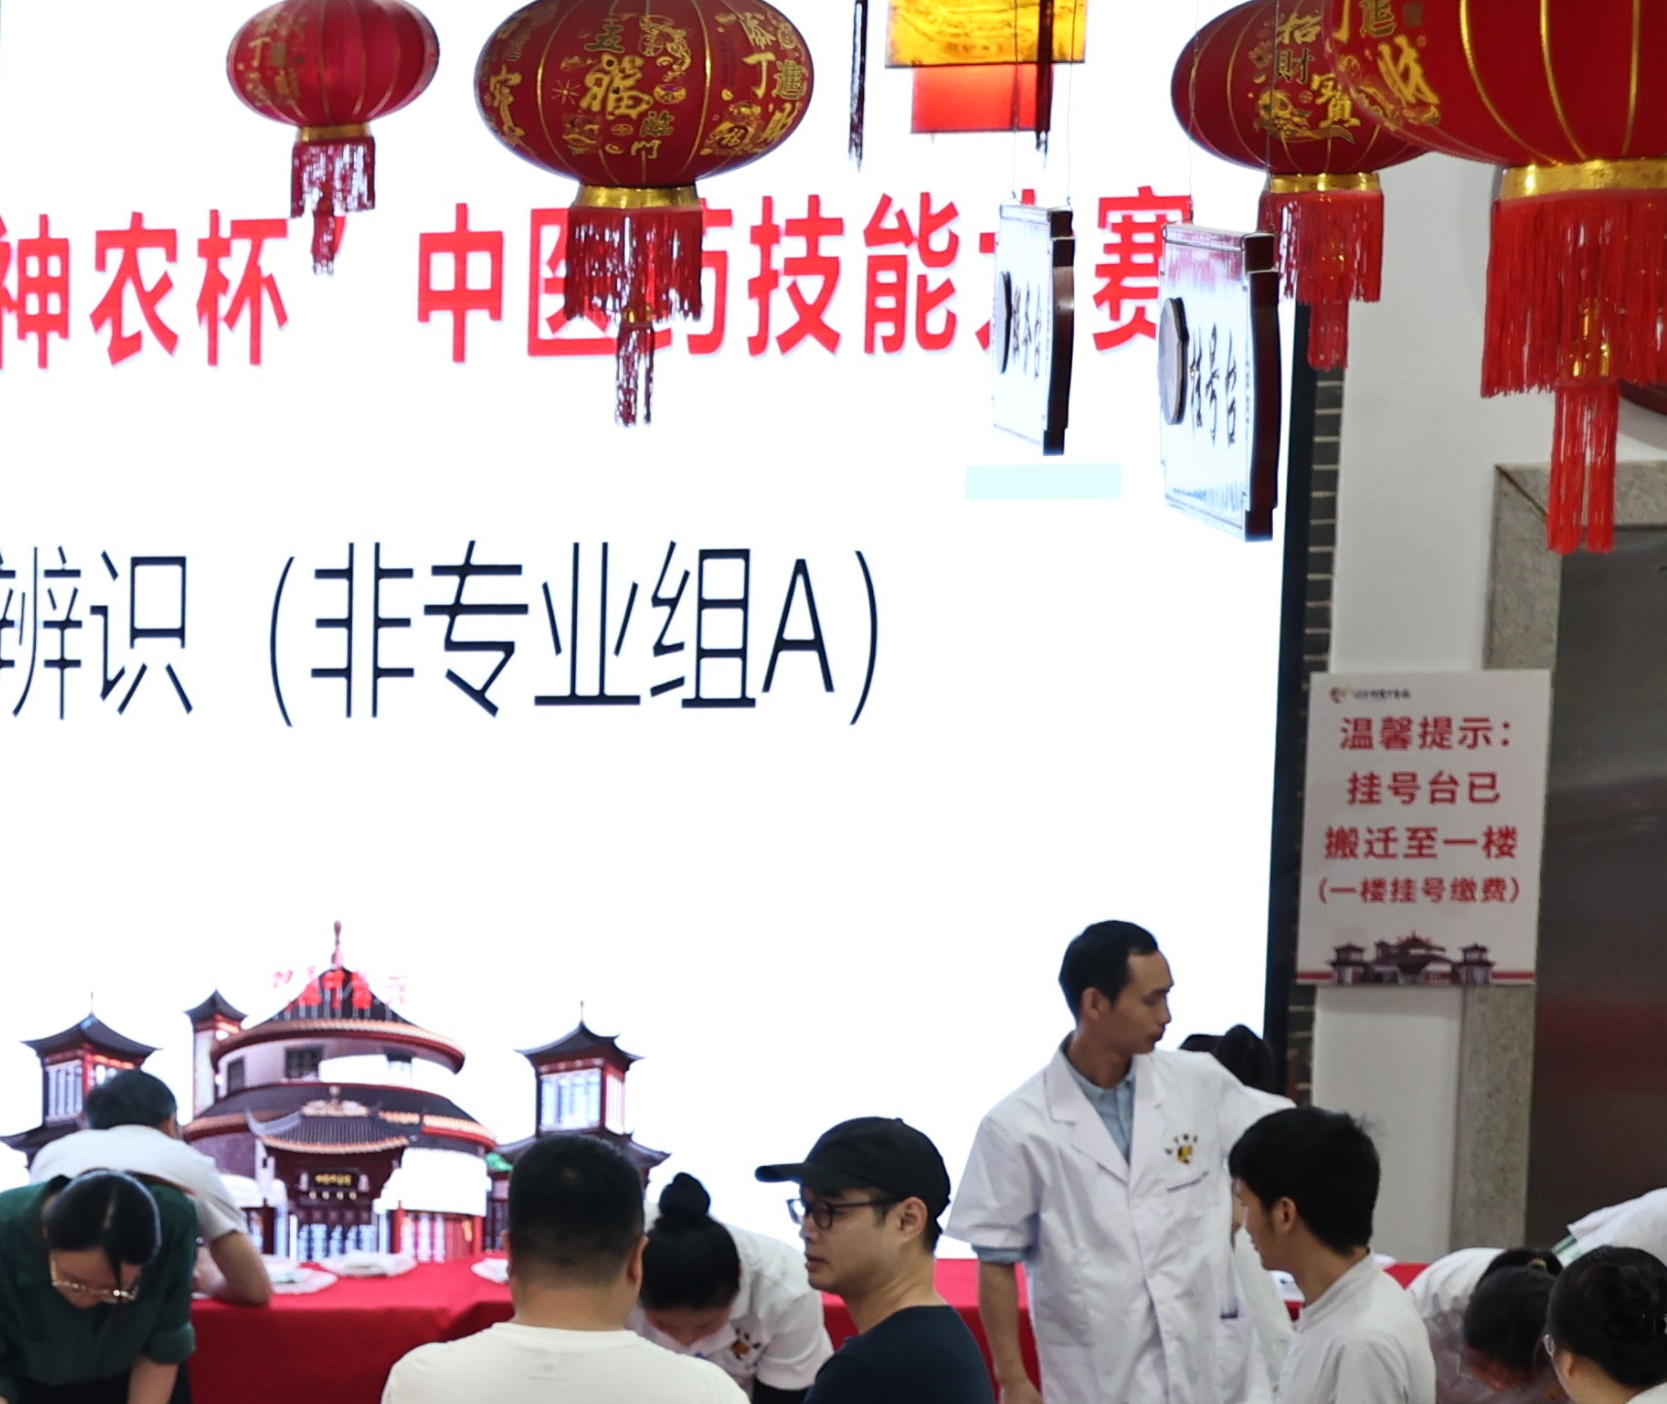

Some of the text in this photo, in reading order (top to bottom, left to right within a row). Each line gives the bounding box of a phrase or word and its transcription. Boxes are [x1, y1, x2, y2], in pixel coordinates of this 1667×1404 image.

[1348, 770, 1501, 806] 挂号台已
[1323, 825, 1518, 861] 搬迁至一楼
